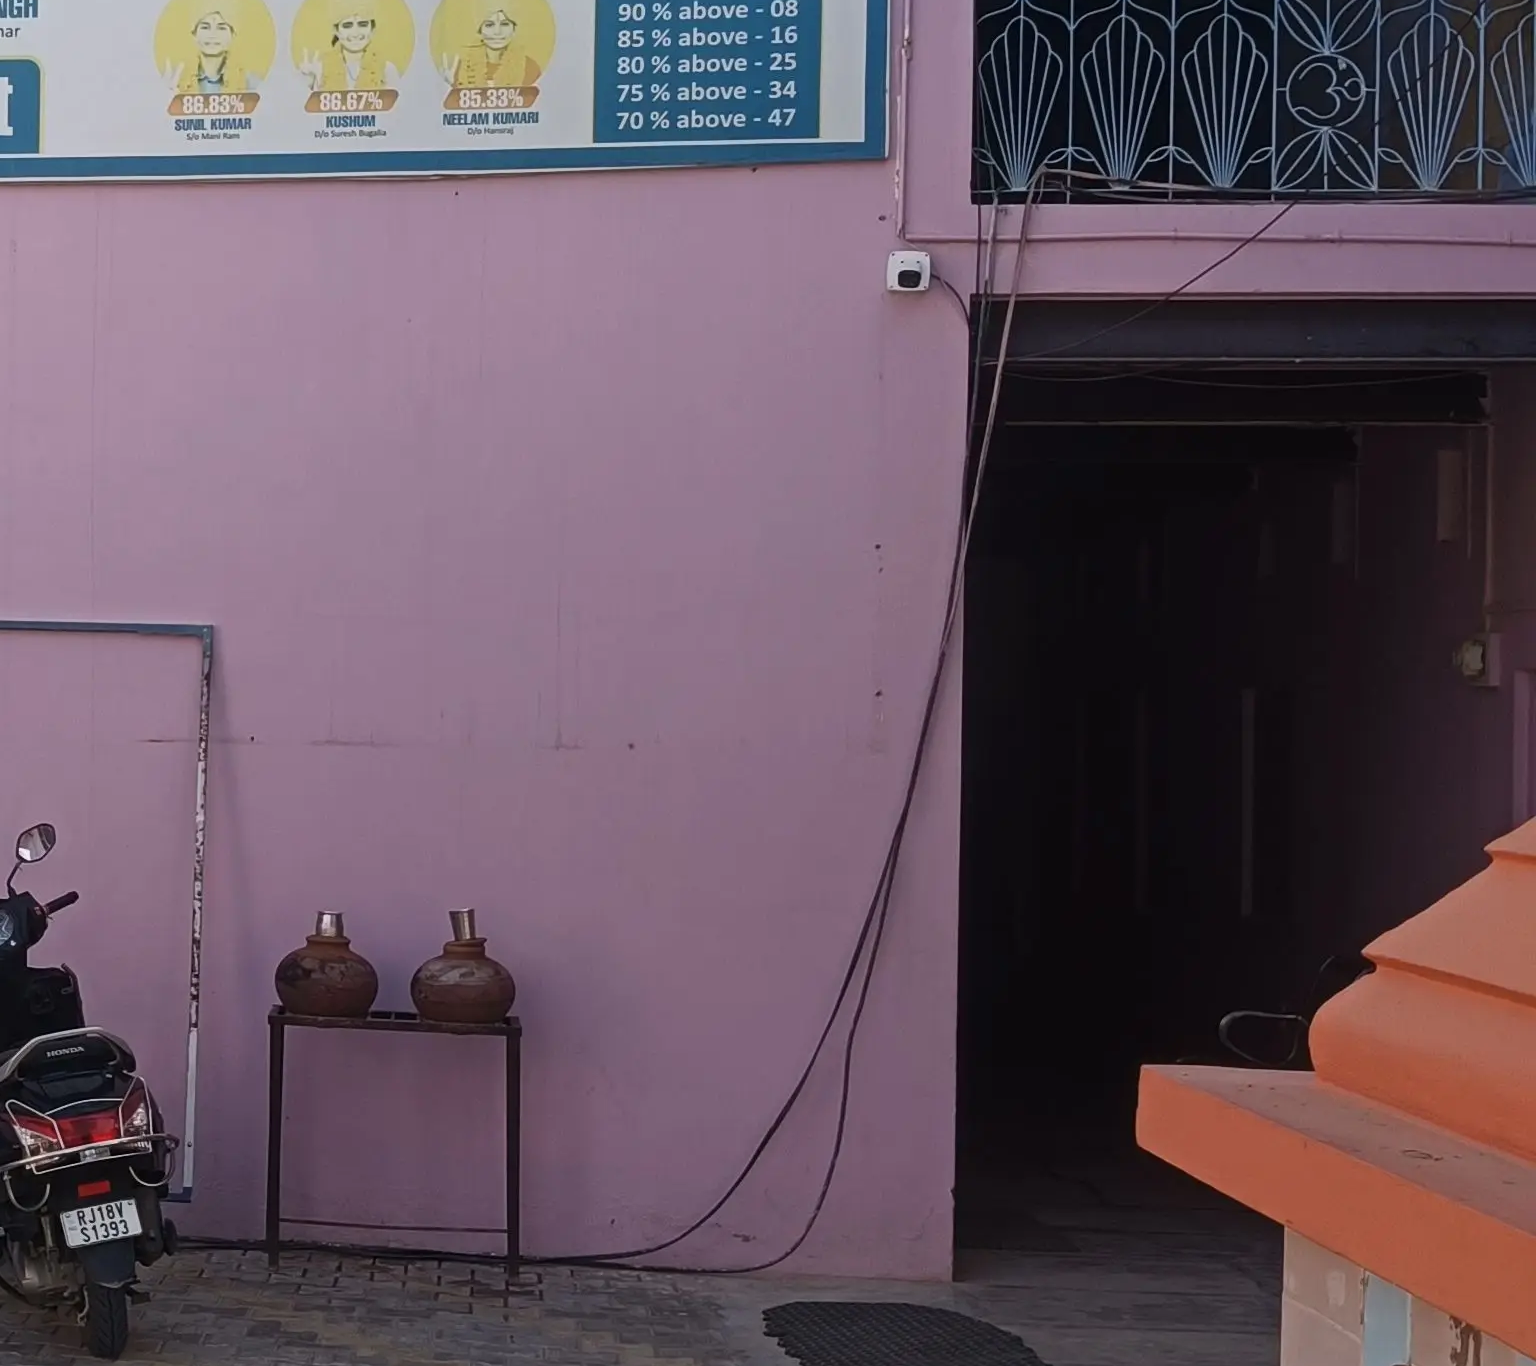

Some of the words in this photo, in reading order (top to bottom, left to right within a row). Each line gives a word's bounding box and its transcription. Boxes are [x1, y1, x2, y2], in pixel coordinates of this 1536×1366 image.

[618, 3, 646, 21] 90
[679, 1, 749, 20] above
[771, 0, 799, 18] 08
[618, 29, 644, 48] 85
[678, 27, 748, 47] above
[770, 25, 798, 44] 16
[616, 56, 644, 75] 80
[678, 53, 748, 73] above
[770, 52, 798, 71] 25
[319, 91, 382, 111] 86.67%
[459, 88, 523, 108] 85.33%
[616, 85, 644, 102] 75
[677, 82, 747, 101] above
[769, 80, 797, 99] 34
[182, 94, 245, 114] 86.83%
[175, 118, 207, 131] SUNIL
[210, 117, 252, 131] KUMAR
[326, 115, 376, 128] KUSHUM
[442, 113, 489, 126] NEELAM
[492, 111, 539, 125] KUMARI
[616, 111, 644, 130] 70
[676, 109, 746, 129] above
[768, 109, 796, 127] 47
[46, 1045, 85, 1058] HONDA
[77, 1201, 124, 1227] RJ18V
[80, 1220, 130, 1242] S1393
